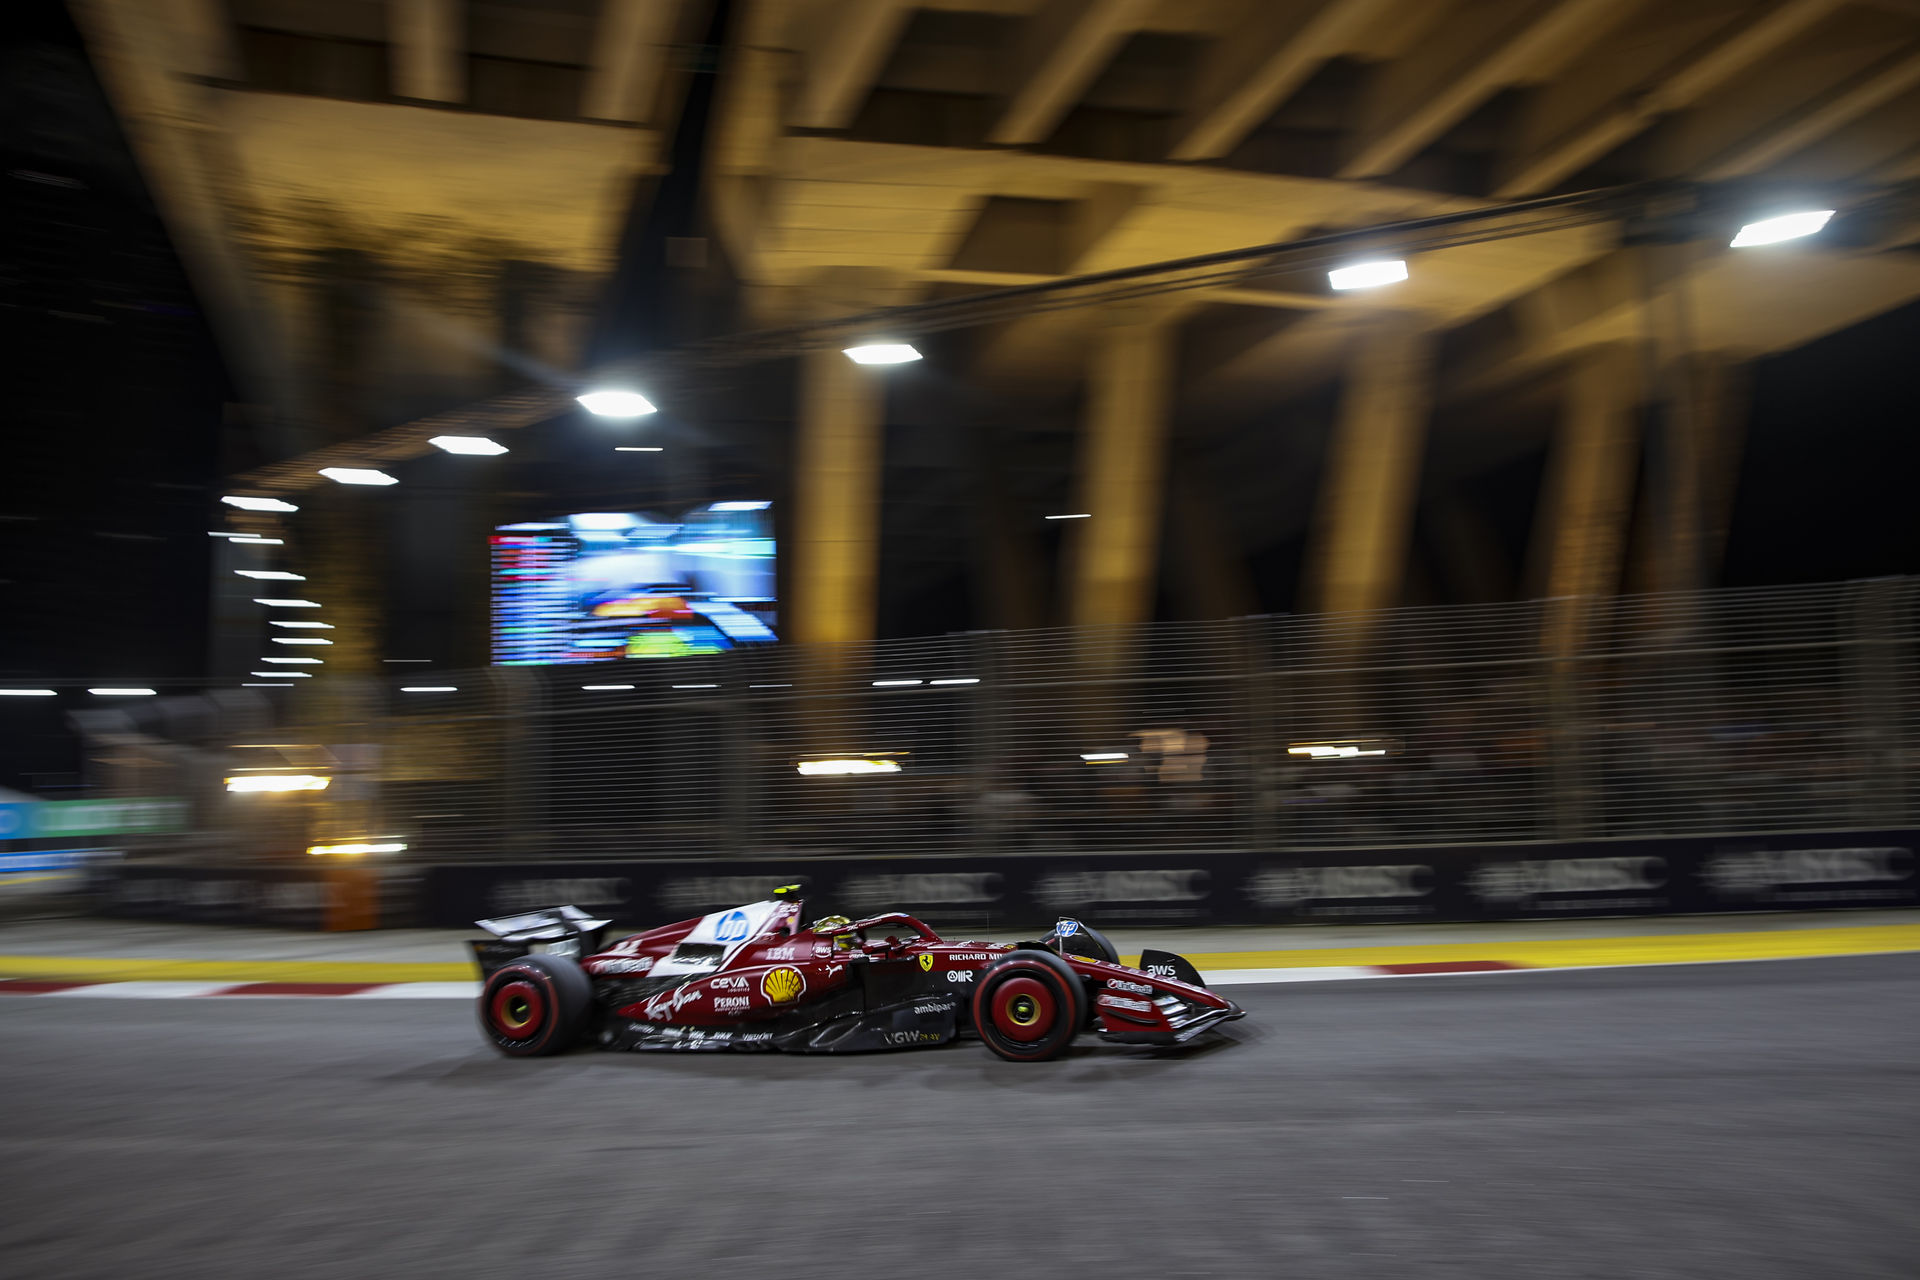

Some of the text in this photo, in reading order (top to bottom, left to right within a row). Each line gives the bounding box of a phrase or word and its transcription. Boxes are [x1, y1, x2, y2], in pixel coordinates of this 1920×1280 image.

[716, 911, 748, 941] hp
[1057, 921, 1078, 937] hp
[766, 947, 796, 961] IBM
[815, 946, 832, 955] aws
[949, 953, 986, 961] RICHARD
[1147, 964, 1176, 976] aws
[710, 977, 750, 989] CEVA
[714, 996, 750, 1008] PERONI
